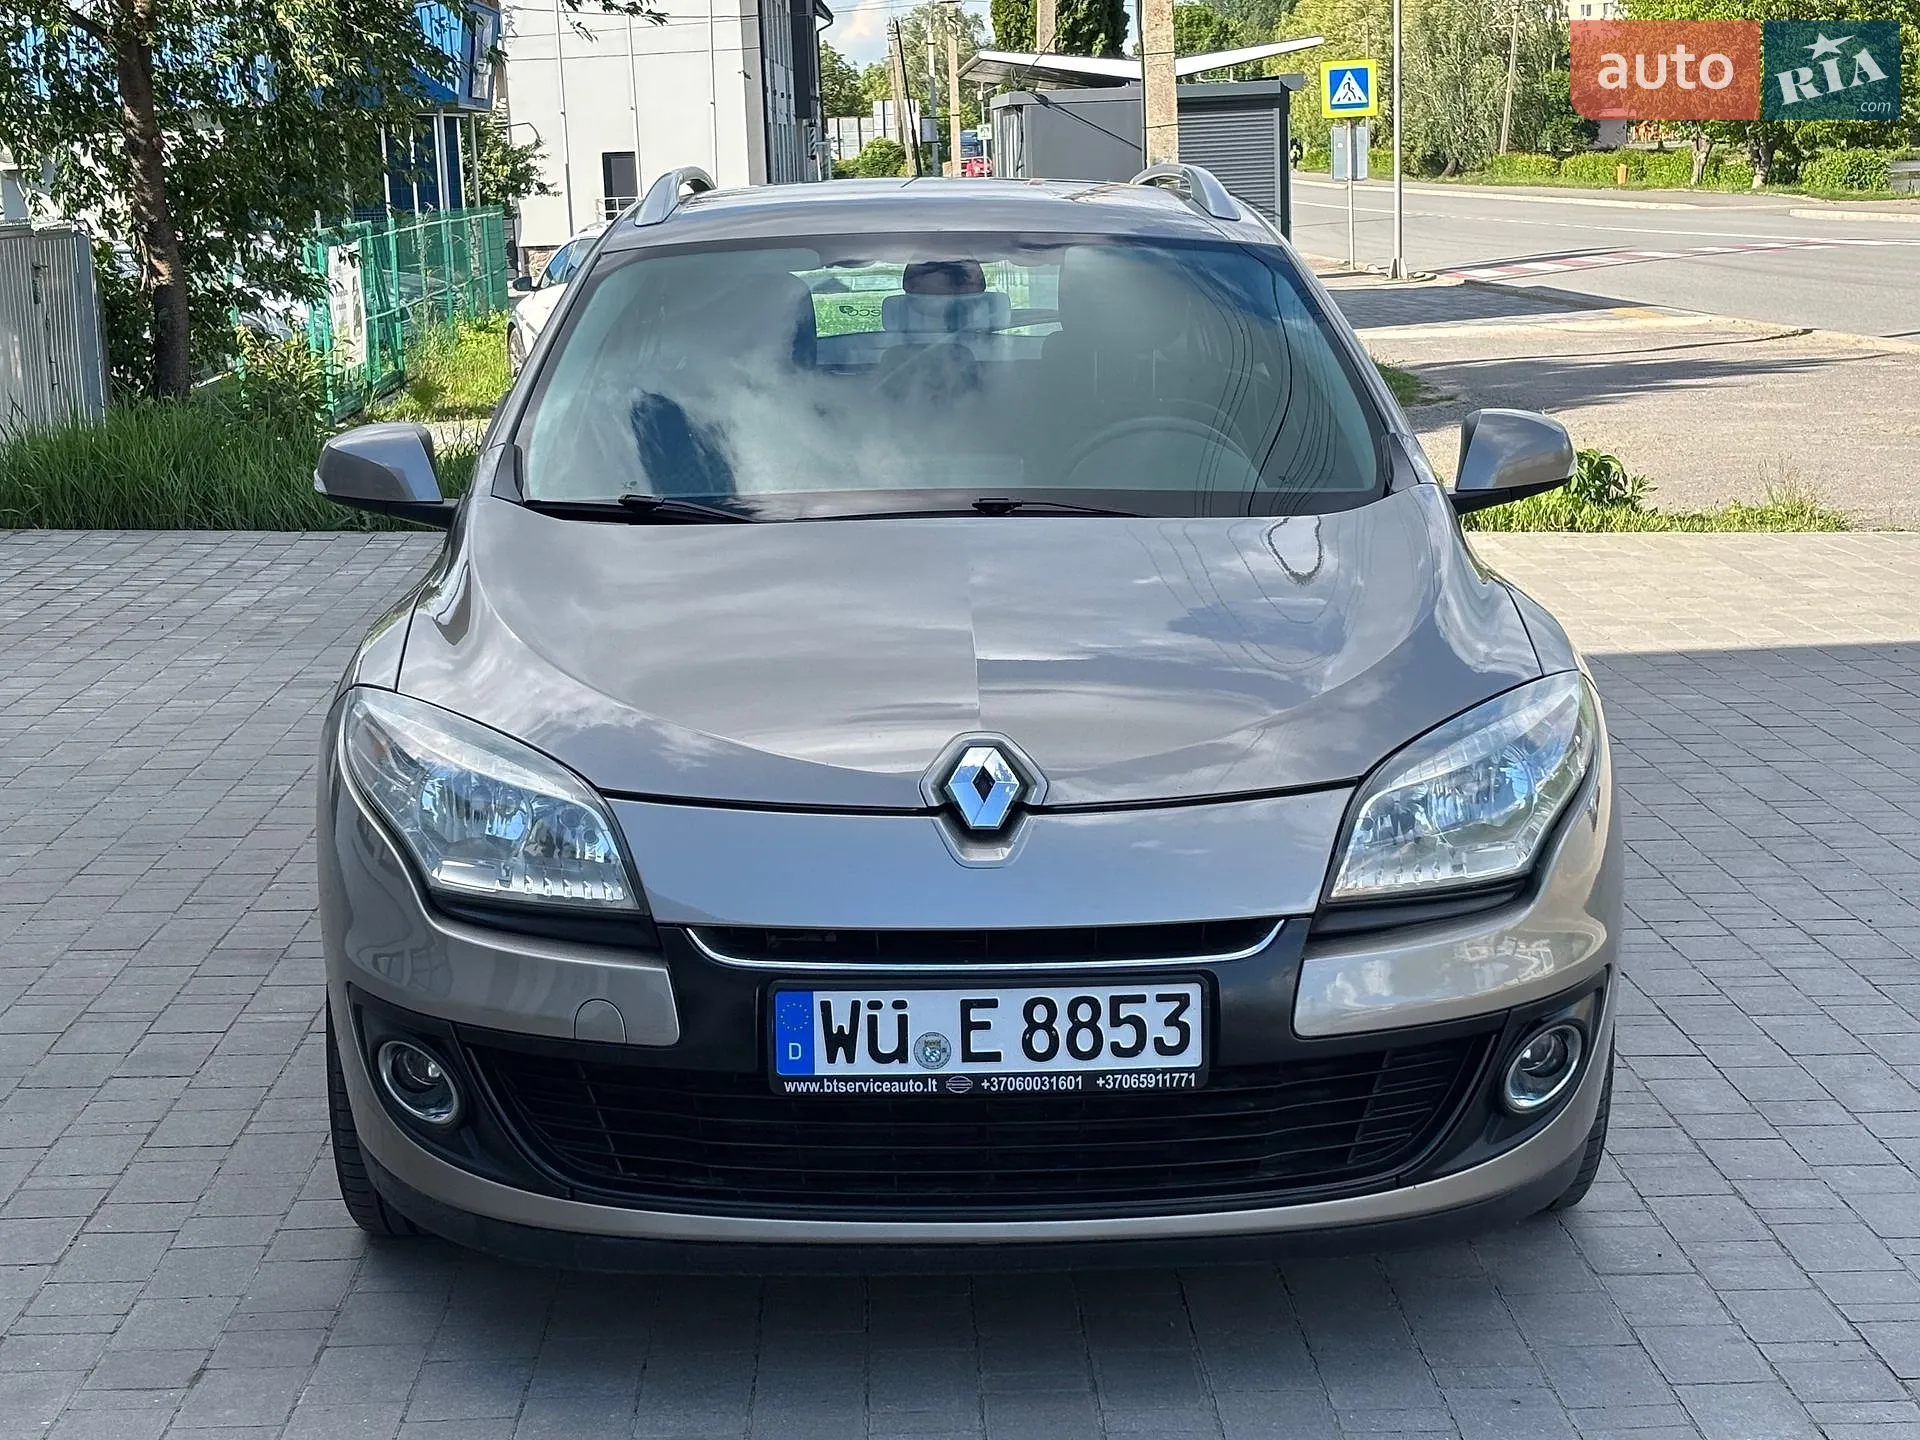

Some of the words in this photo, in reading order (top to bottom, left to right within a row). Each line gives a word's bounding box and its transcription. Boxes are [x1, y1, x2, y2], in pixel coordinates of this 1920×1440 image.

[819, 999, 909, 1065] WÜ
[960, 998, 1002, 1063] E
[1021, 993, 1191, 1063] 8853
[788, 1042, 802, 1060] D
[784, 1078, 938, 1094] www.btserviceauto.lt
[980, 1076, 1083, 1092] +37060031601
[1096, 1073, 1196, 1090] +37065911771
